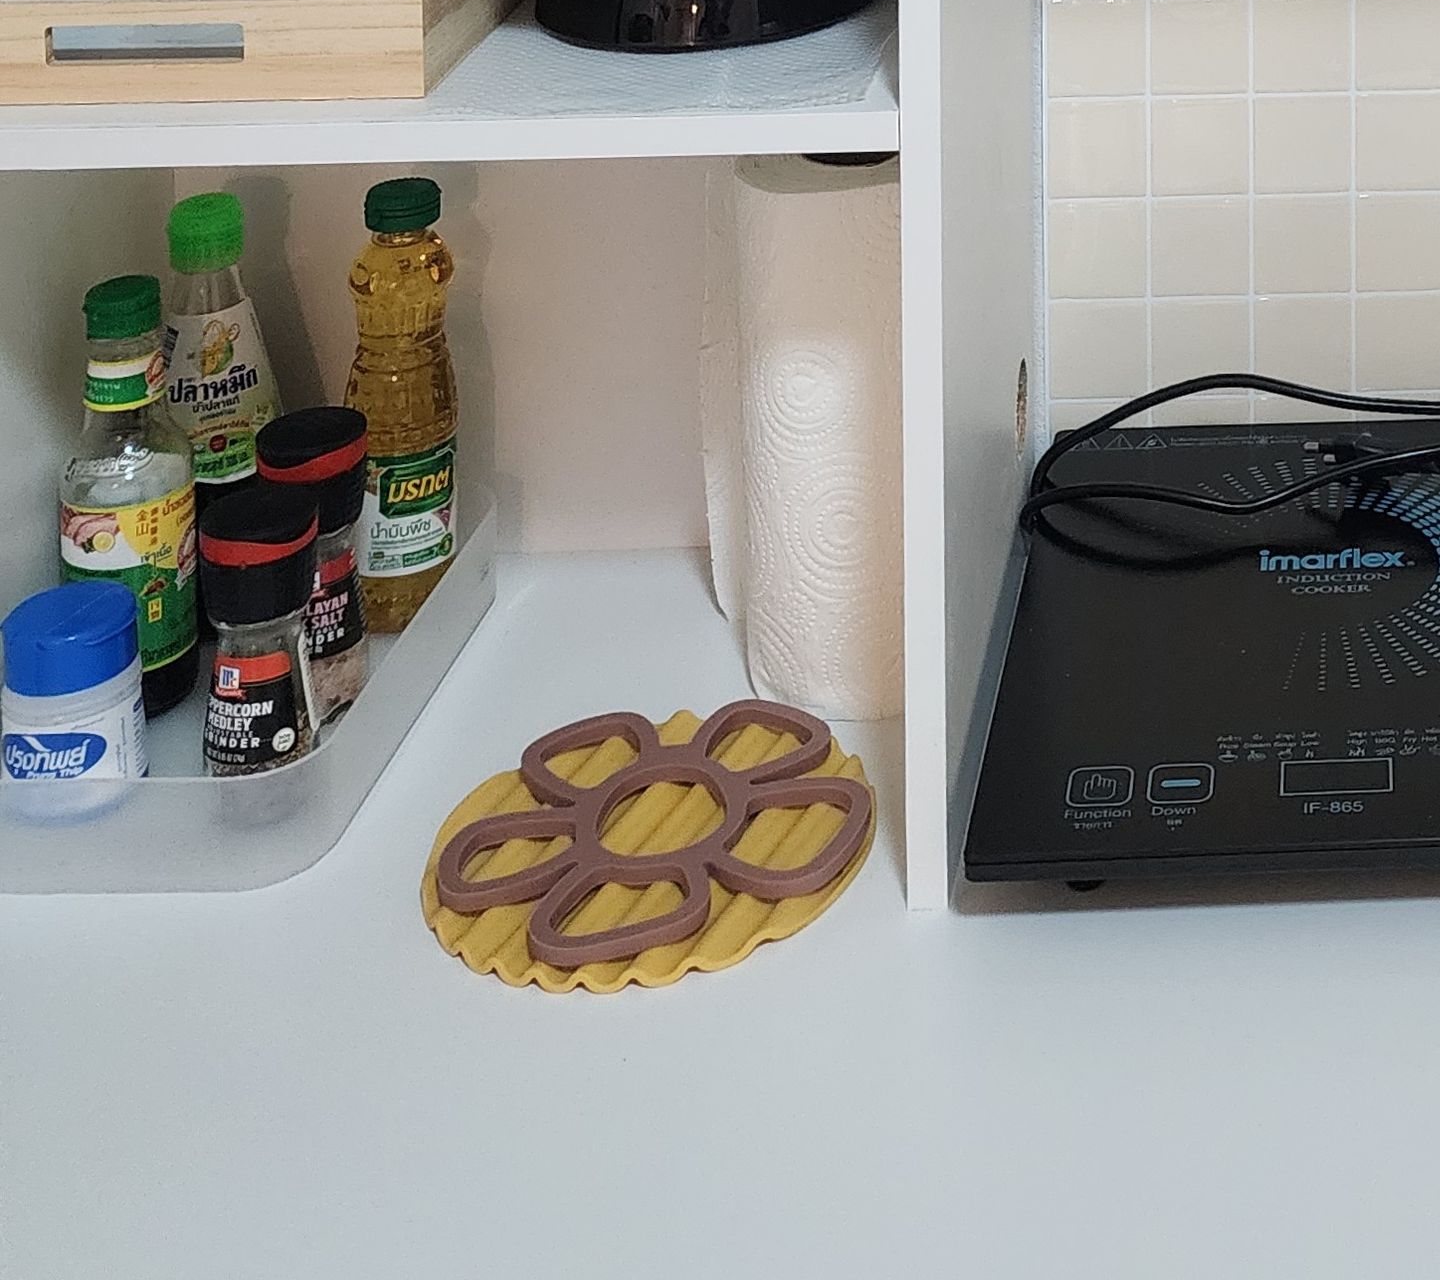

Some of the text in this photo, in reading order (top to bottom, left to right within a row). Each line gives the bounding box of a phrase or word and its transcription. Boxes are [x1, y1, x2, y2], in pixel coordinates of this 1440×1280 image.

[168, 363, 259, 404] ปลาหมึก
[386, 466, 451, 504] มรกต
[370, 518, 432, 539] น้ำมันพืช
[1259, 548, 1405, 571] imarflex
[1277, 572, 1391, 584] INDUCTION
[1290, 584, 1372, 595] COOKER
[305, 591, 348, 617] LAYAN
[312, 607, 345, 630] SALT
[306, 627, 345, 646] NDER
[1064, 809, 1132, 820] Function
[1151, 806, 1197, 816] Down
[1303, 800, 1364, 815] IF-865
